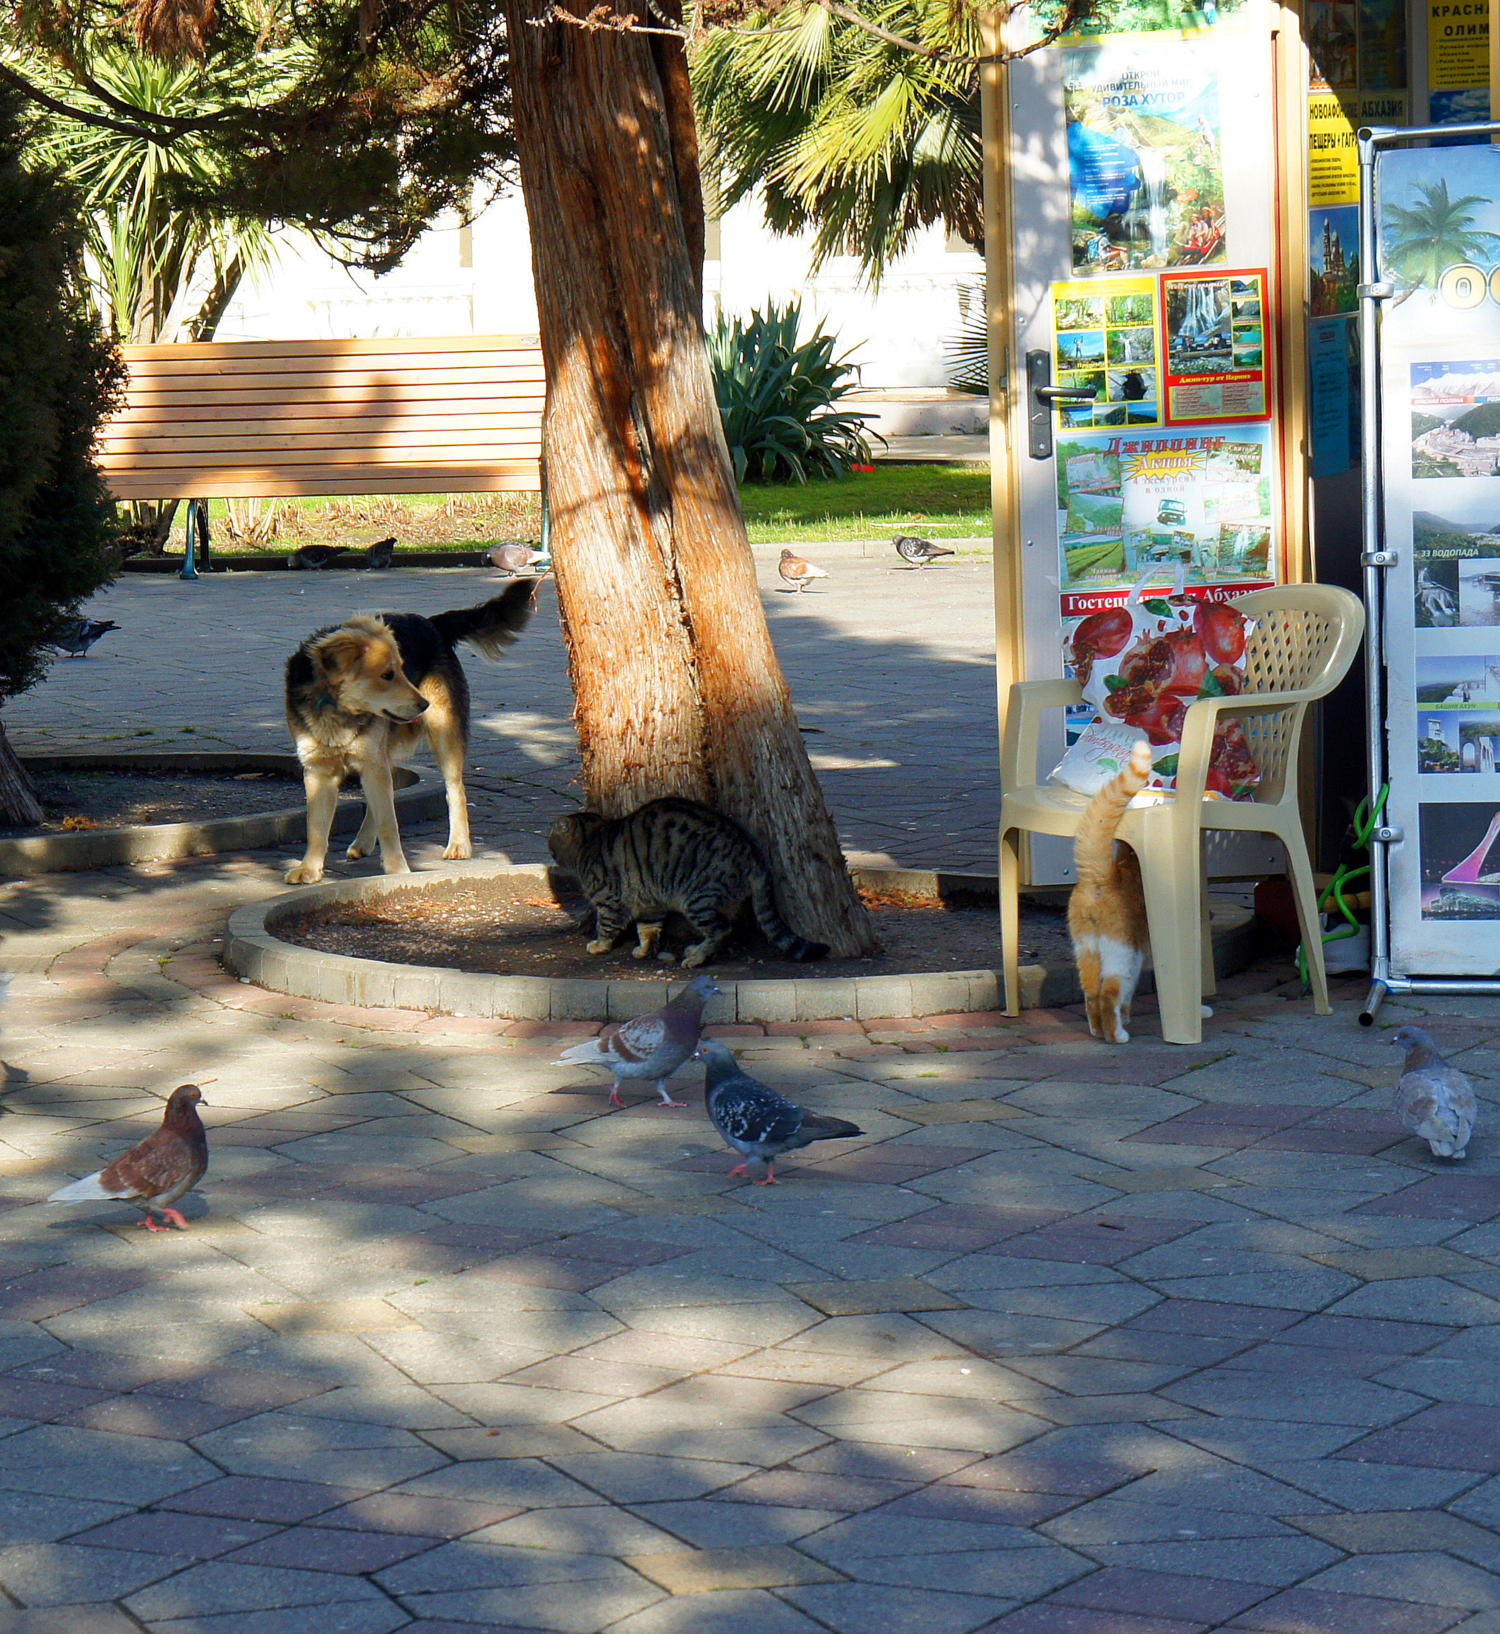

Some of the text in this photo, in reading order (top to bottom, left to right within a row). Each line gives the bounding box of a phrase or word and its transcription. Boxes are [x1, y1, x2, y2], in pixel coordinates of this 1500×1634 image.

[1091, 79, 1168, 93] УДИВИТЕЛЬНЫЙ
[1102, 91, 1186, 107] РОЗА ХУТОР
[1361, 100, 1403, 118] АБХАЗИЯ
[1309, 133, 1336, 152] ПЕЩЕРЫ
[1103, 436, 1226, 459] Джиппинг
[1137, 456, 1193, 472] Акция
[1132, 477, 1138, 485] 4
[1432, 548, 1479, 558] ВОДОПАДА
